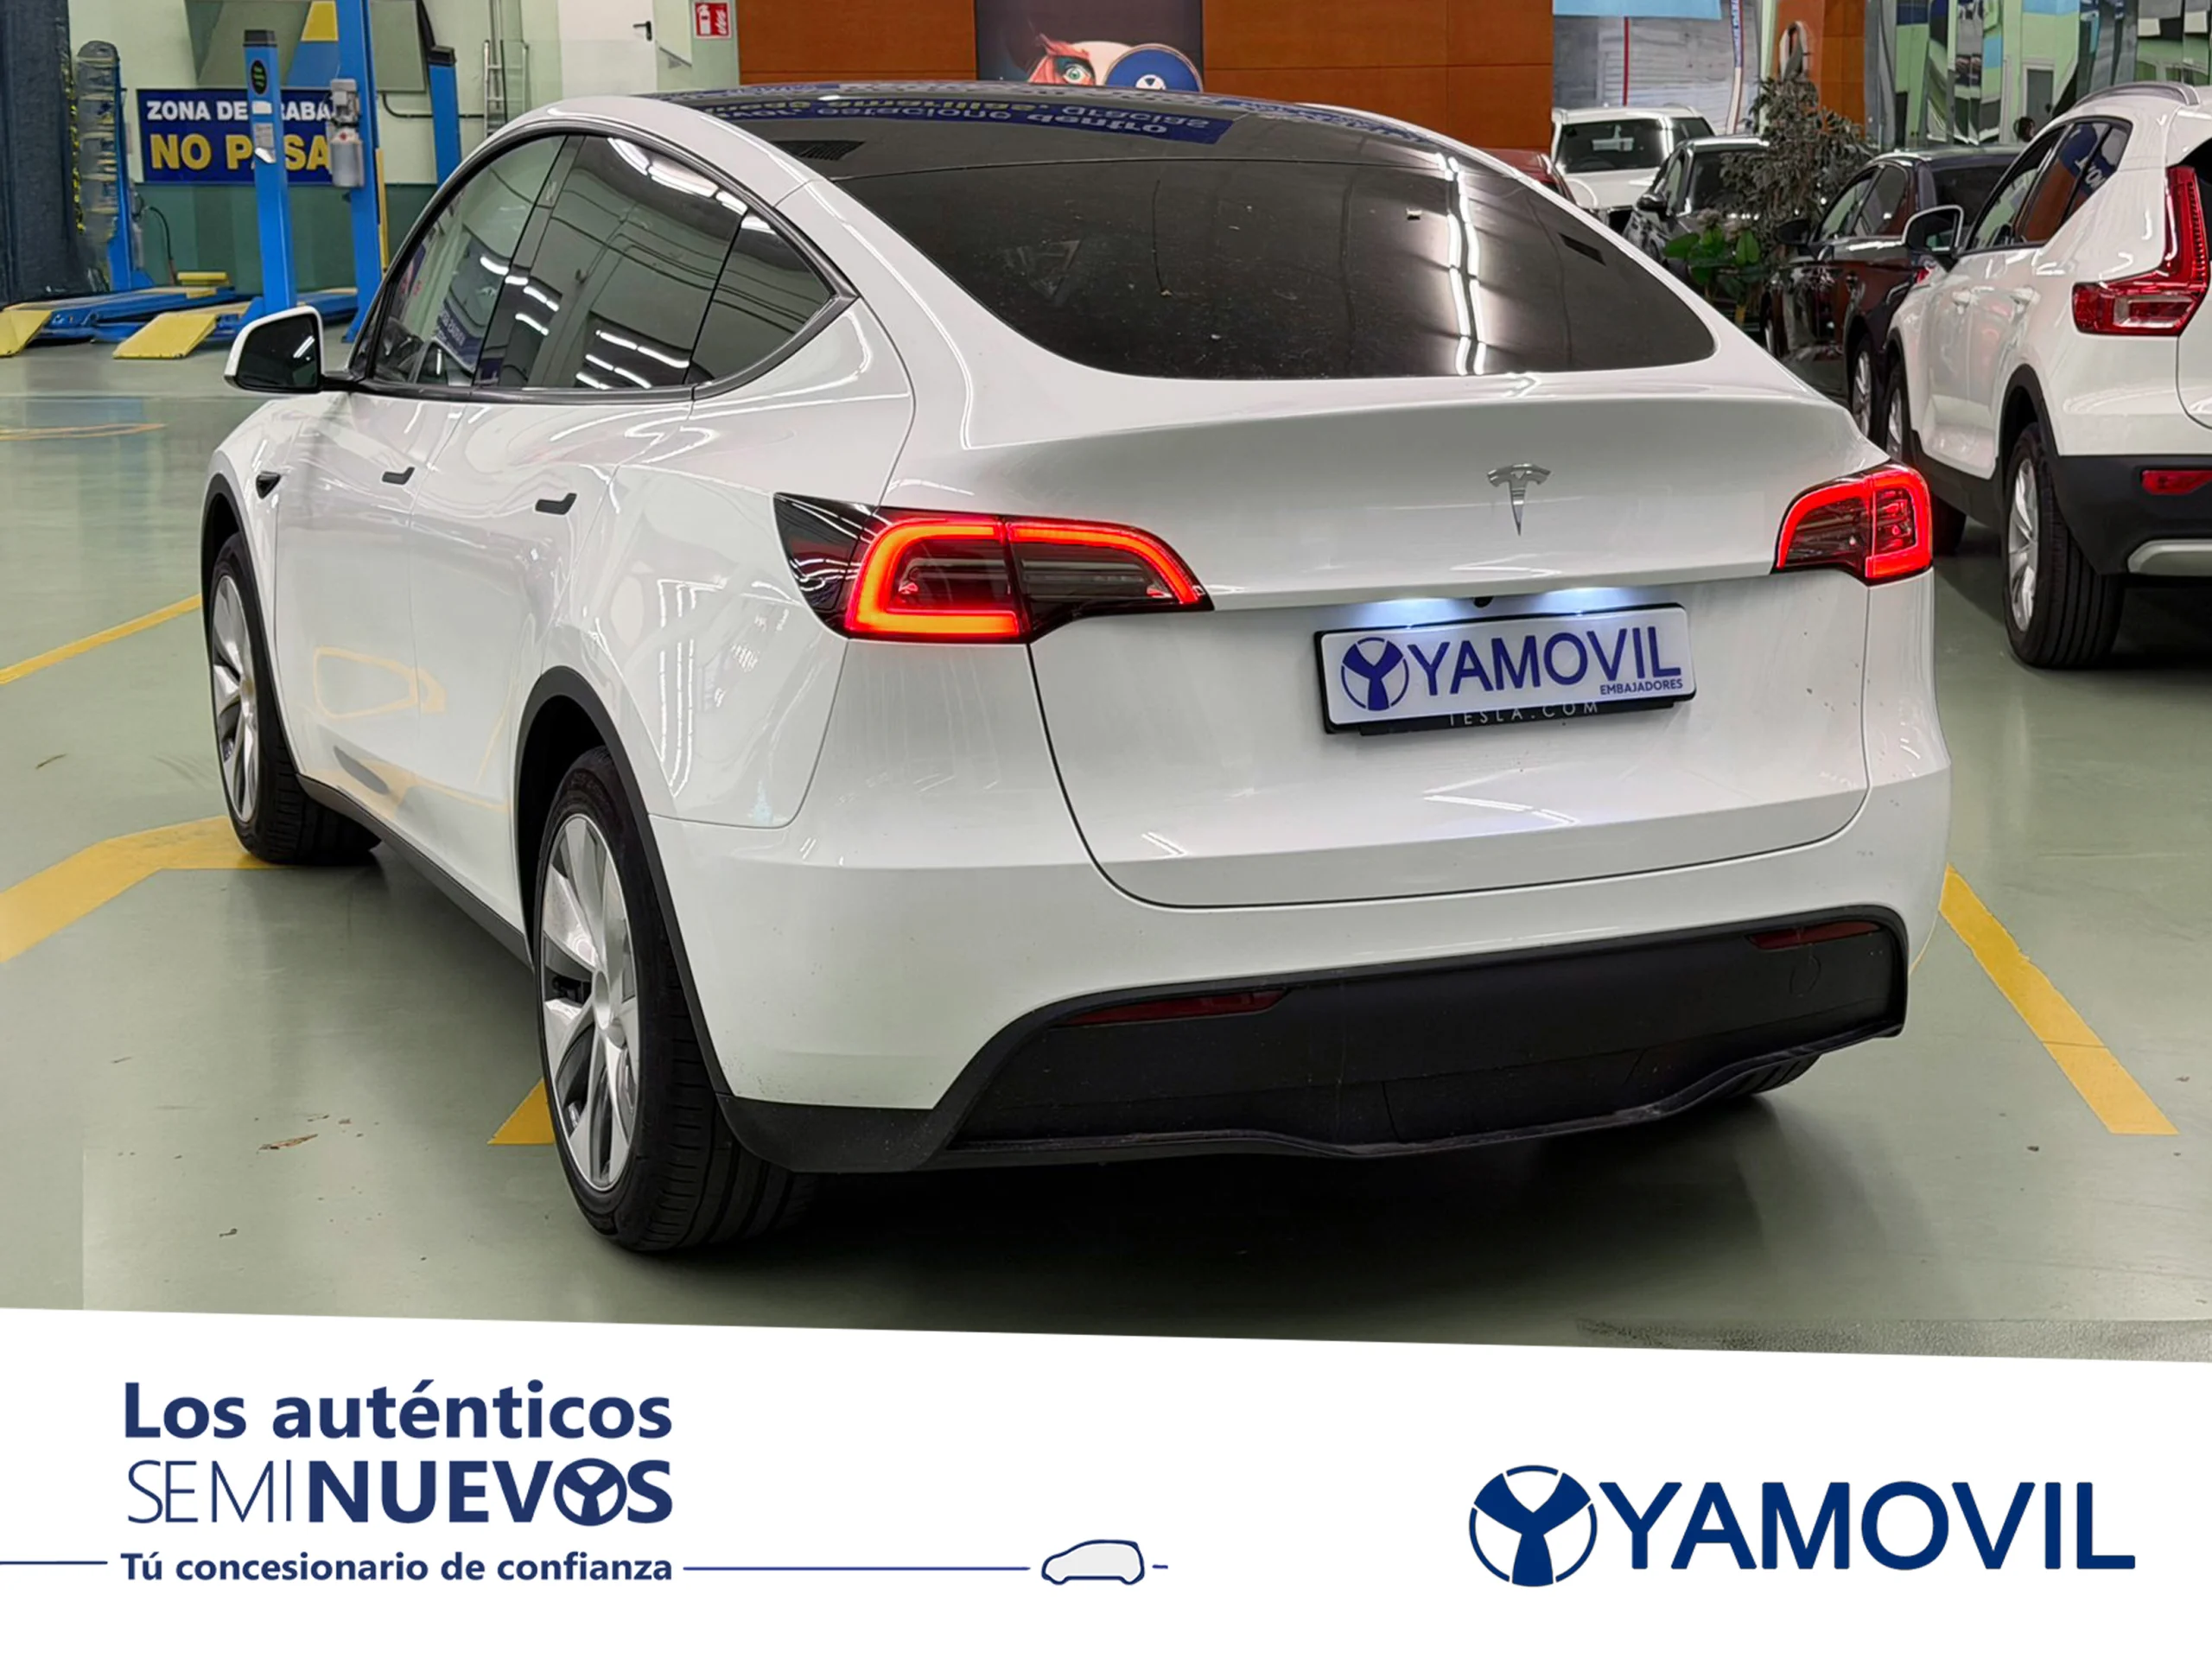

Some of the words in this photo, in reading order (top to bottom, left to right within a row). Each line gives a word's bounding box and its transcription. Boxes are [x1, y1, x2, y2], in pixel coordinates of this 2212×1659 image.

[146, 101, 211, 120] ZONA
[216, 101, 248, 120] DE
[150, 133, 212, 170] NO
[226, 133, 330, 170] PSA
[1407, 626, 1681, 696] YAMOVIL
[1599, 678, 1683, 695] EMBAJADORES
